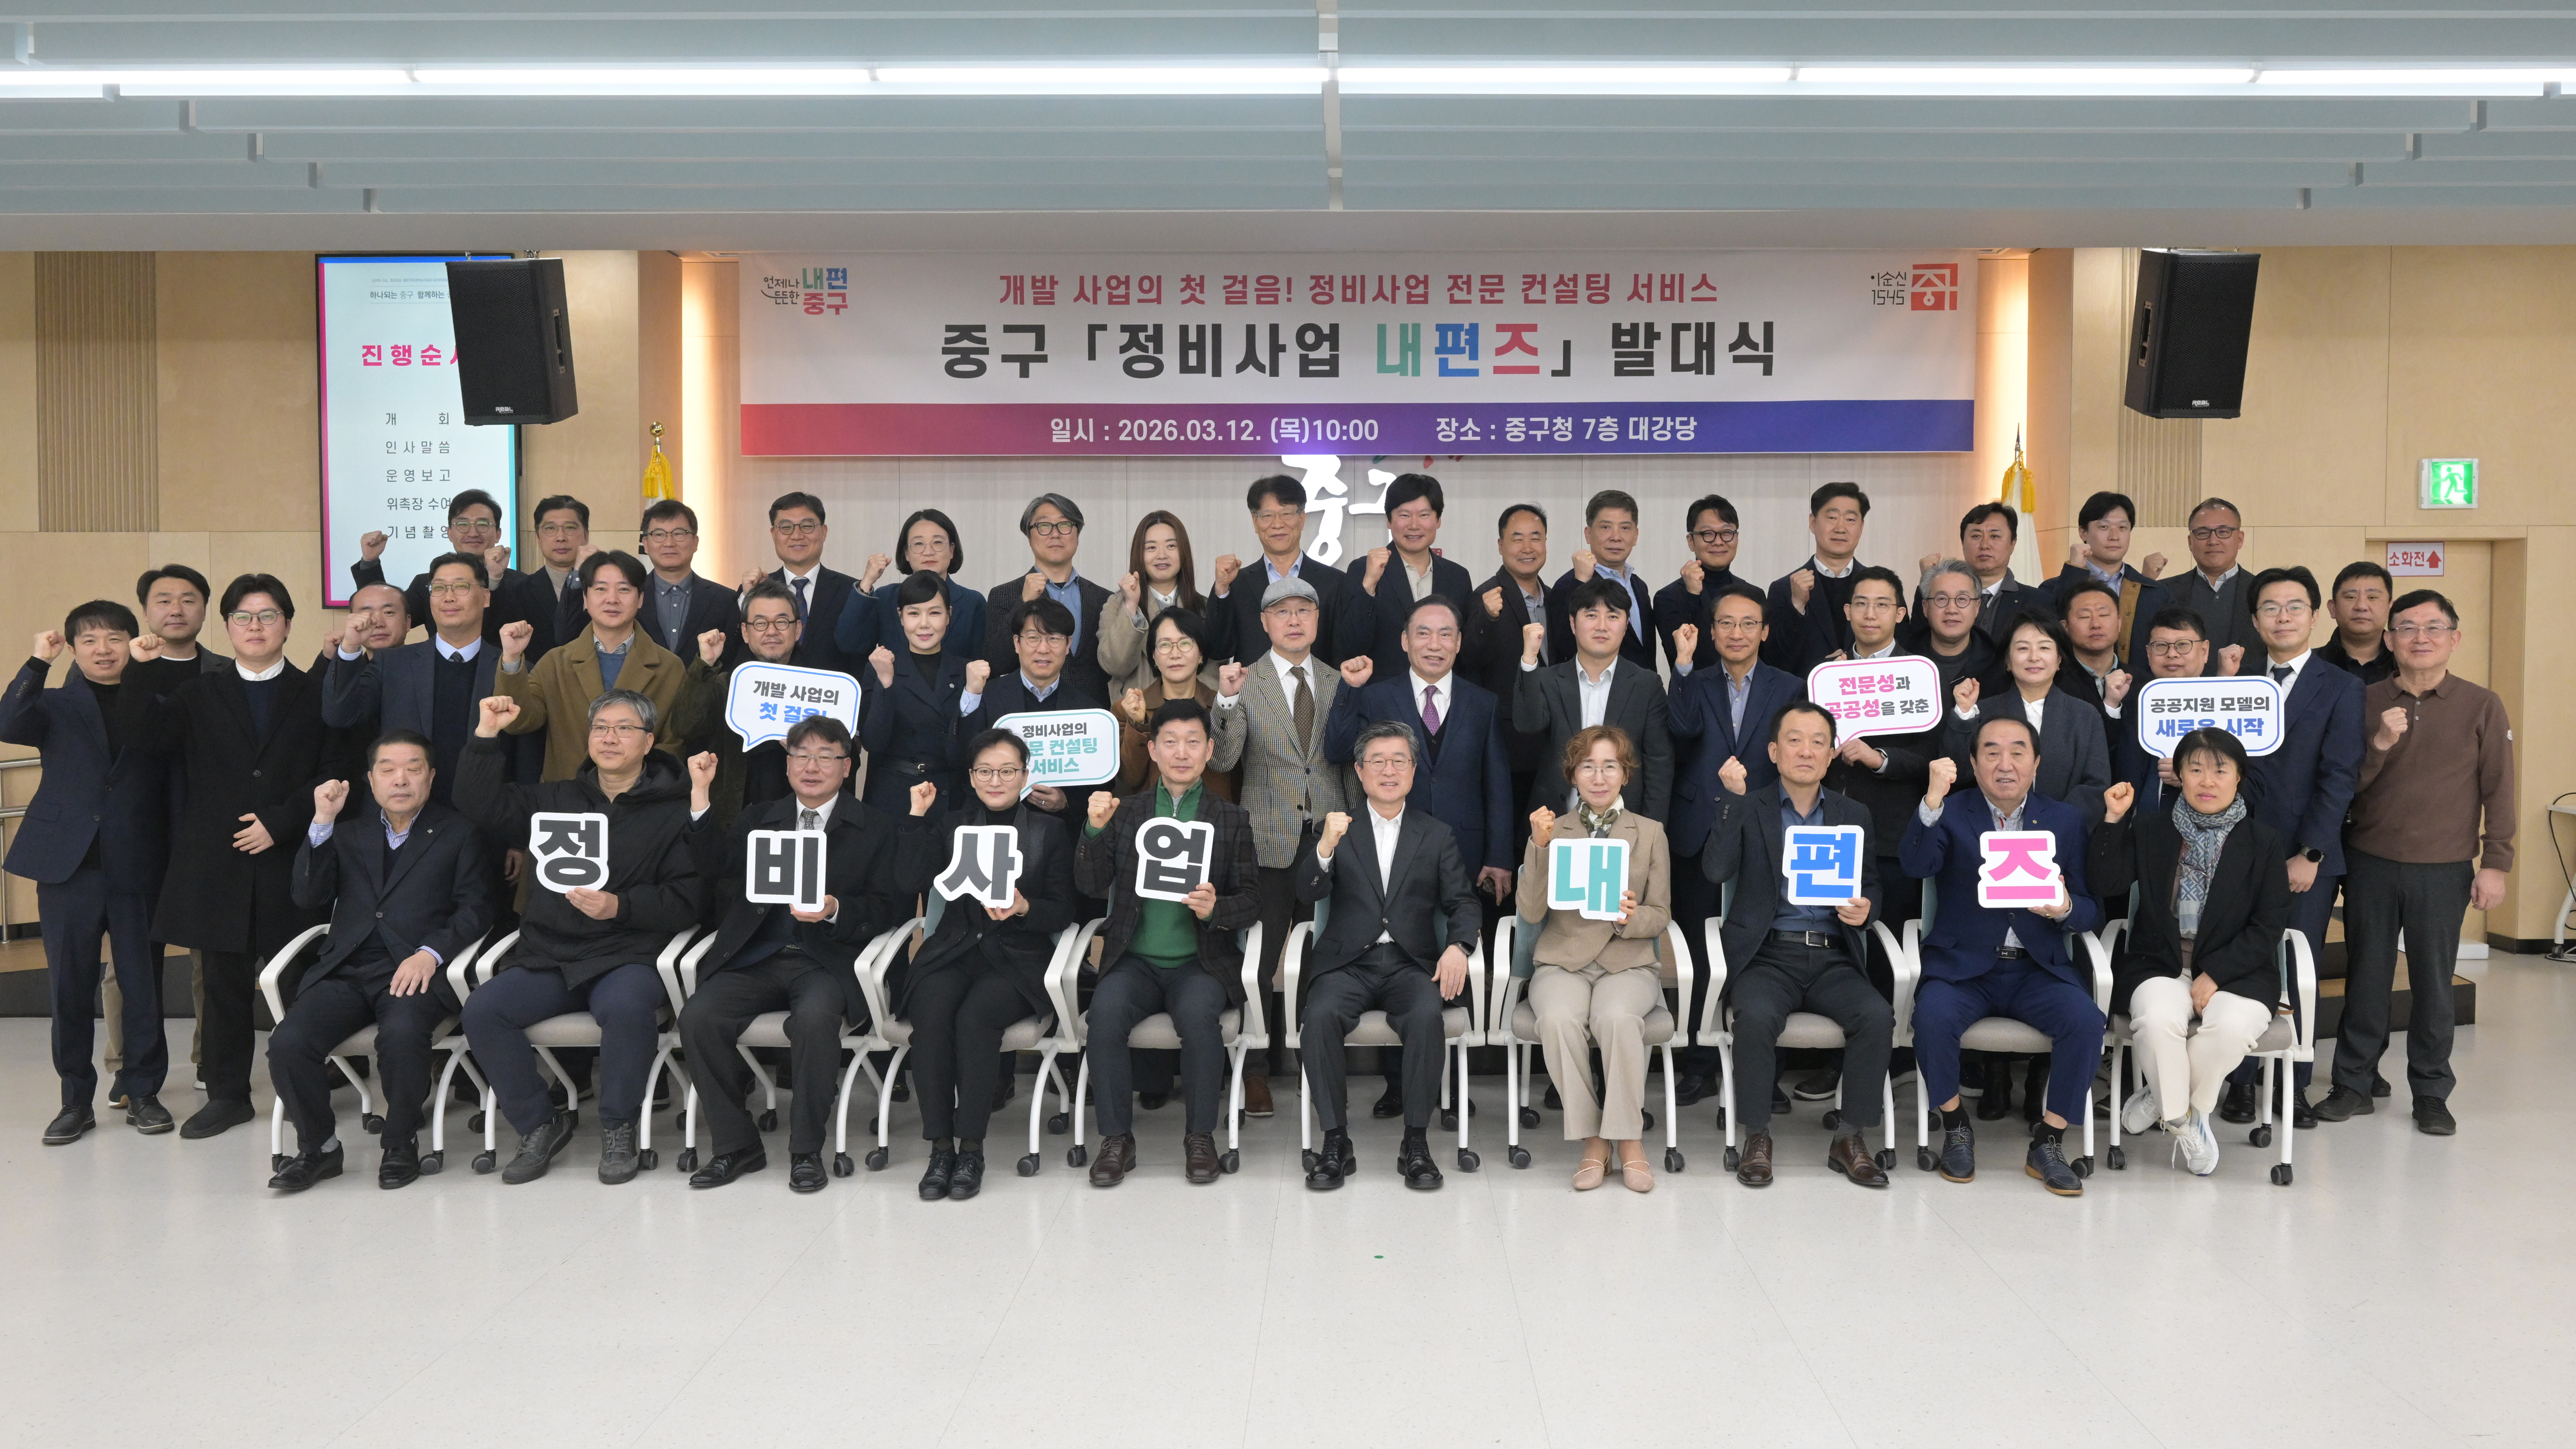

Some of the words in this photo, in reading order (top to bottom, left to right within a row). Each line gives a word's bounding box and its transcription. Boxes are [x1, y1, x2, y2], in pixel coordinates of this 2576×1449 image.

[763, 276, 800, 289] 언제나
[802, 268, 847, 290] 내편
[1000, 275, 1059, 306] 개발
[1073, 275, 1162, 306] 사업의
[1180, 274, 1205, 305] 첫
[1222, 275, 1292, 305] 걸음!
[1309, 274, 1429, 305] 정비사업
[1447, 274, 1505, 304] 전문
[1521, 273, 1610, 305] 컨설팅
[1627, 273, 1717, 304] 서비스
[1870, 271, 1906, 287] 이순신
[418, 291, 445, 299] 함께하는
[774, 290, 800, 305] 든든한
[803, 292, 848, 315] 중구
[1871, 289, 1905, 305] 1545
[942, 324, 1048, 379] 중구
[1087, 323, 1340, 379] 「정비사업
[1377, 323, 1571, 378] 내편즈」
[1611, 321, 1774, 377] 발대식
[1050, 418, 1094, 442] 일시
[1104, 425, 1109, 441] :
[1118, 419, 1261, 441] 2026.03.12.
[1271, 417, 1379, 443] (목)10:00
[1436, 417, 1481, 442] 장소
[1490, 424, 1495, 440] :
[1505, 416, 1572, 442] 중구청
[1582, 416, 1619, 441] 7층
[1629, 416, 1697, 441] 대강당
[387, 497, 423, 510] 위촉장
[428, 497, 451, 510] 수여
[2389, 551, 2424, 567] 소화전
[753, 680, 787, 699] 개발
[790, 685, 839, 705] 사업의
[1839, 674, 1911, 695] 전문성과
[759, 702, 778, 721] 첫
[1825, 699, 1895, 720] 공공성을
[1900, 698, 1929, 715] 갖춘
[2150, 697, 2215, 713] 공공지원
[2220, 696, 2270, 711] 모델의
[1022, 722, 1087, 738] 정비사업의
[2226, 718, 2264, 737] 시작
[1025, 740, 1044, 757] 문
[1049, 738, 1097, 756] 컨설팅
[1031, 757, 1079, 774] 서비스
[537, 819, 601, 886] 정
[1143, 824, 1207, 894] 업
[754, 837, 819, 904] 비
[942, 833, 1015, 900] 사
[1790, 833, 1856, 898] 편
[1986, 838, 2056, 900] 즈
[1555, 846, 1622, 913] 내
